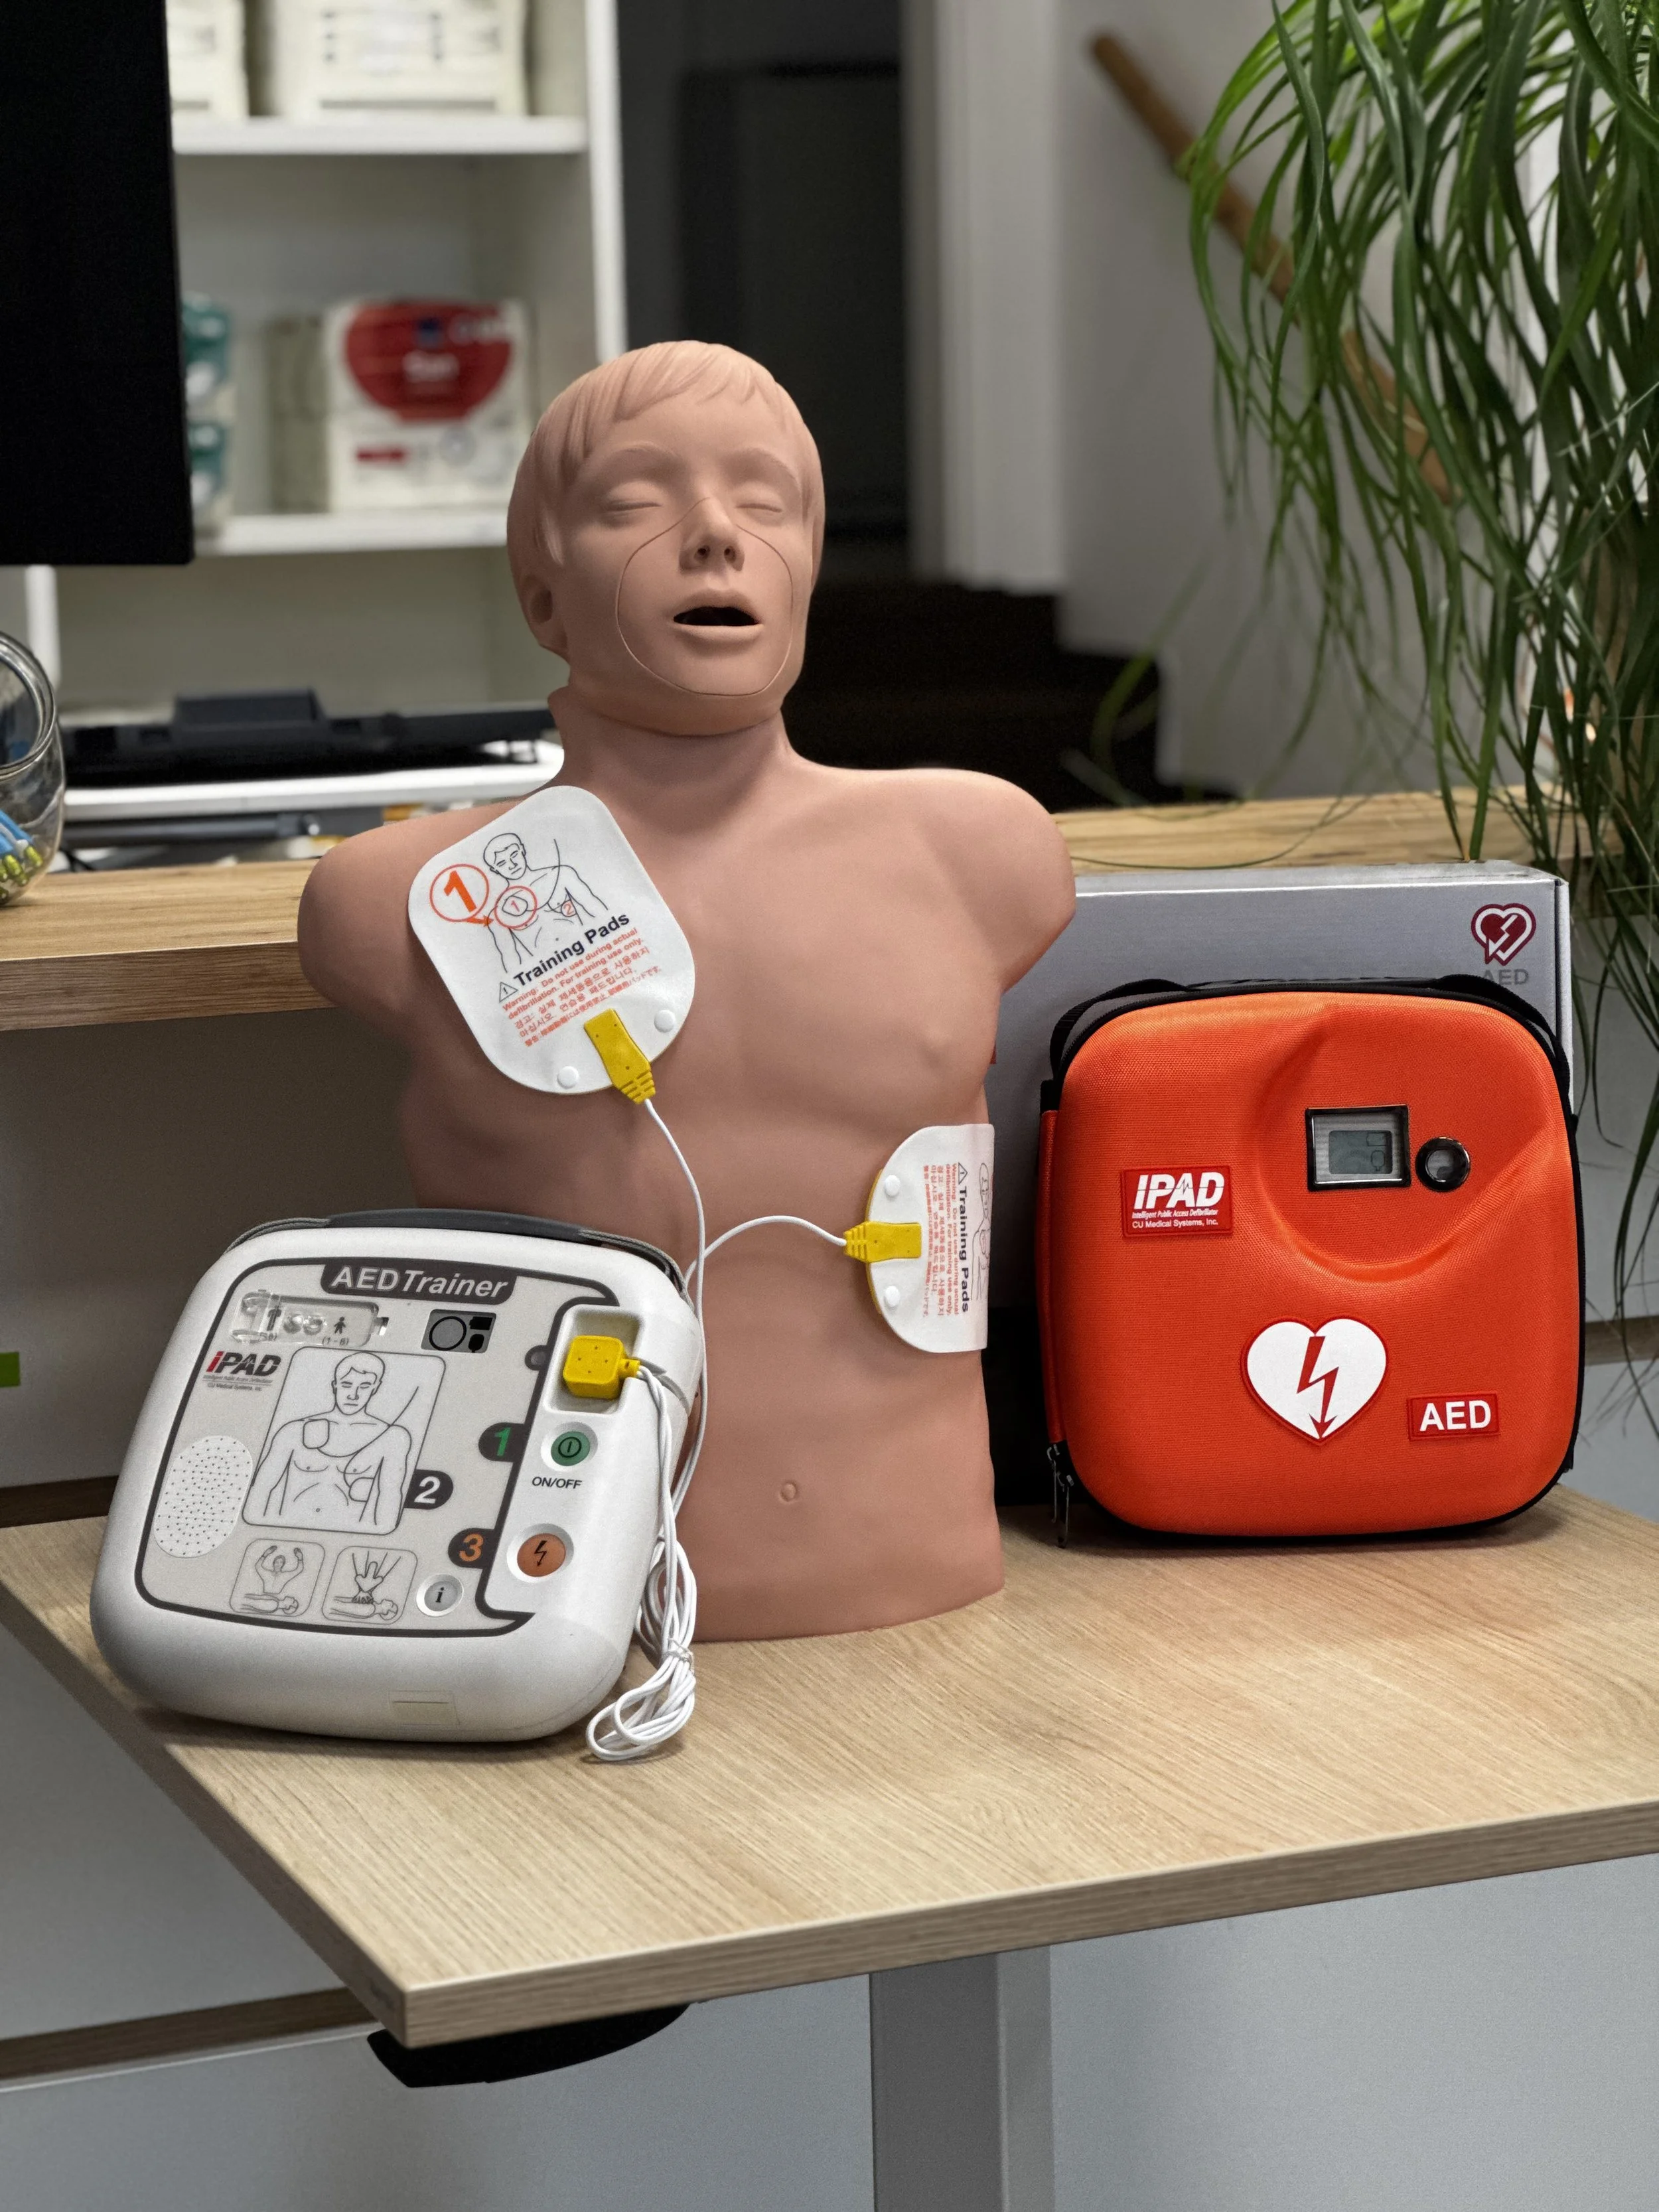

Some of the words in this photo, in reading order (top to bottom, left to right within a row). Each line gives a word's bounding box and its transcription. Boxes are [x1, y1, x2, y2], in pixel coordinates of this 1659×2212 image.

[443, 869, 476, 913] 1
[513, 940, 585, 986] Training
[584, 914, 629, 944] Pads
[502, 988, 538, 1011] Warning:
[541, 976, 554, 987] Do
[553, 968, 569, 980] not
[569, 958, 584, 971] use
[584, 942, 613, 962] during
[613, 928, 637, 945] actual
[559, 975, 574, 987] For
[573, 956, 607, 978] training
[607, 948, 622, 960] use
[1483, 969, 1529, 986] AED
[952, 1207, 958, 1220] Do
[959, 1185, 968, 1260] Training
[1131, 1211, 1157, 1220] Intelligent
[1189, 1208, 1218, 1217] Defibrillator
[1173, 1219, 1204, 1228] Systems,
[330, 1266, 399, 1291] AED
[402, 1270, 509, 1298] Trainer
[961, 1267, 970, 1313] Pads
[206, 1351, 281, 1376] iPAD
[1419, 1400, 1492, 1432] AED
[494, 1427, 512, 1457] 1
[414, 1476, 441, 1505] 2
[532, 1476, 583, 1490] ON/OFF
[459, 1533, 484, 1562] 3
